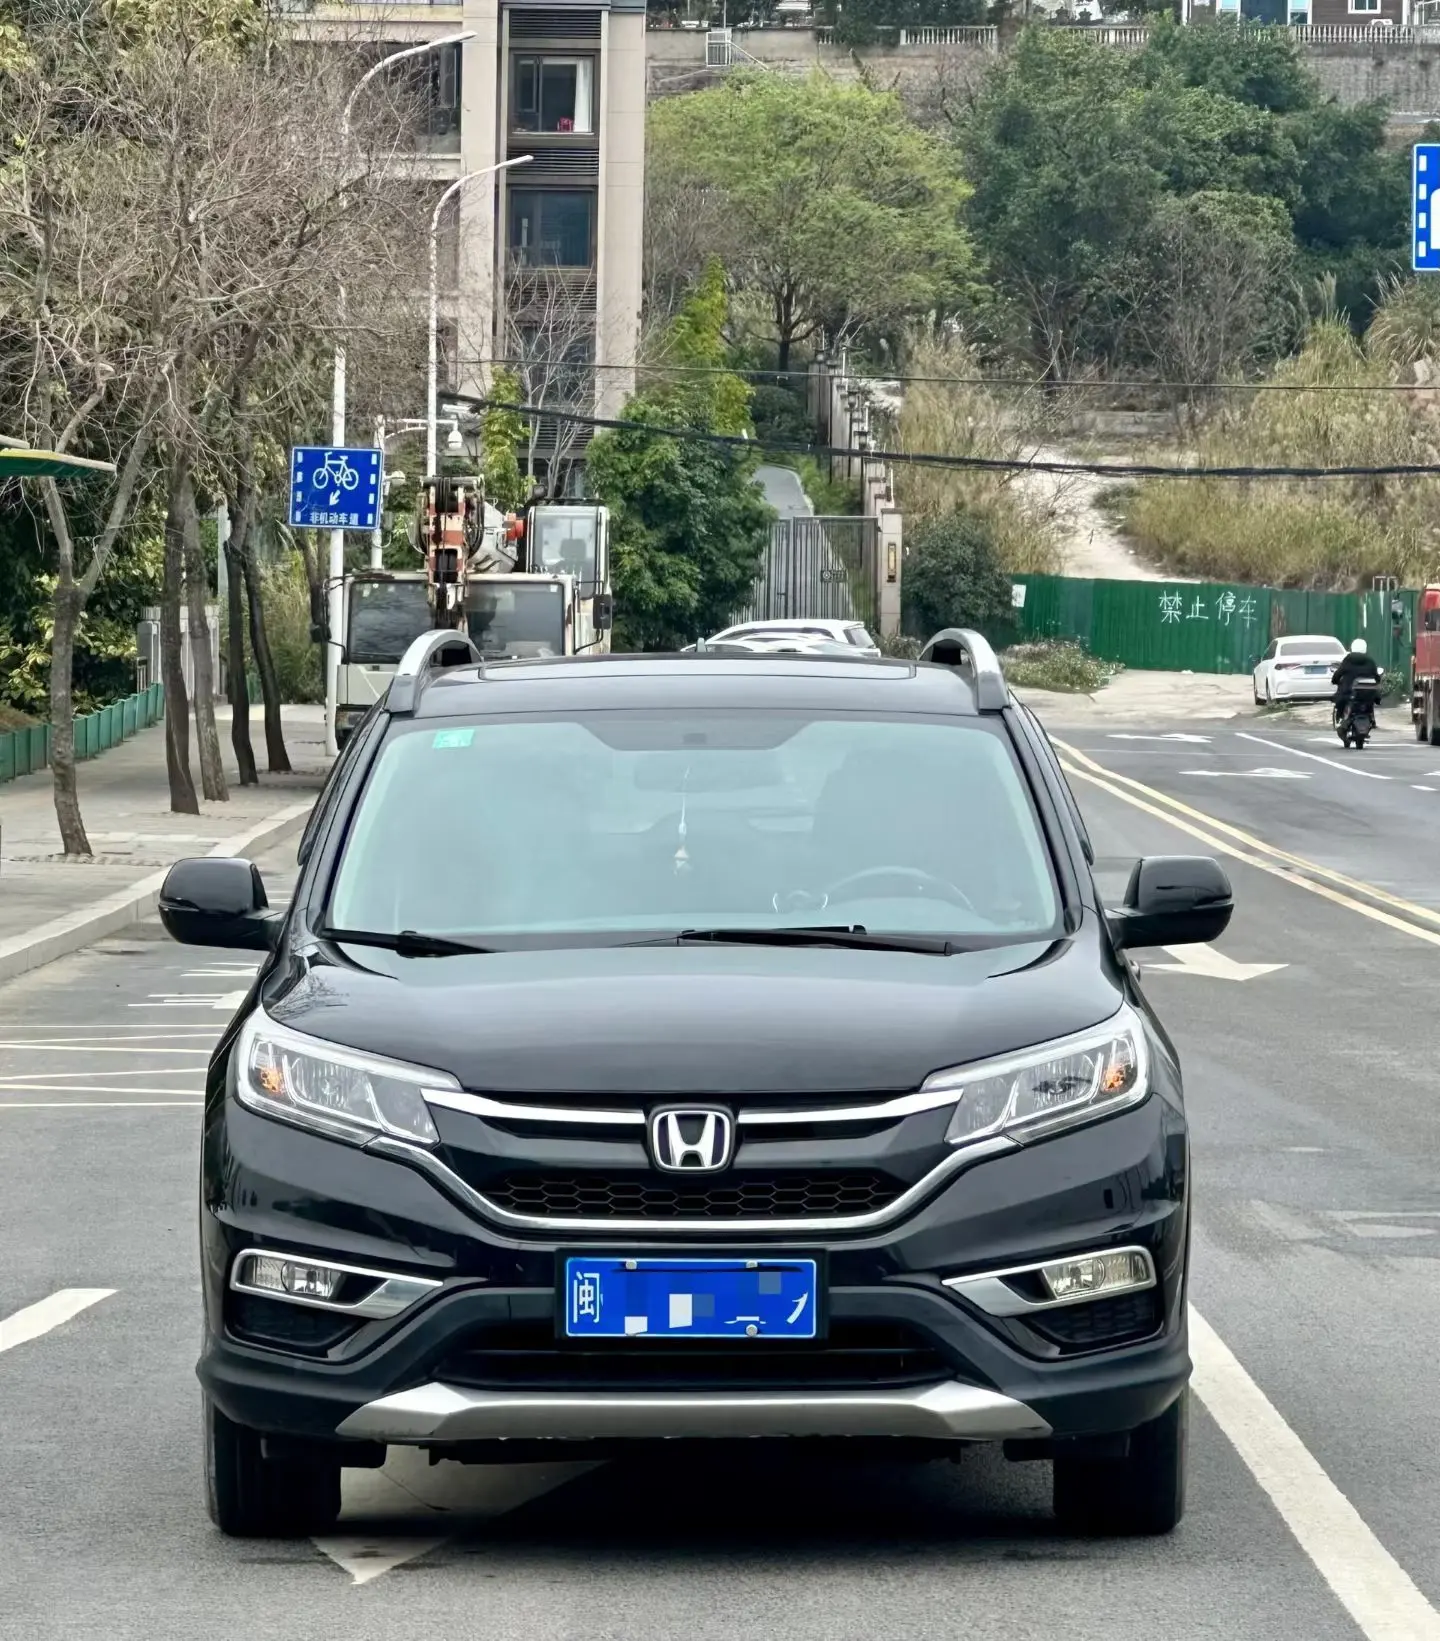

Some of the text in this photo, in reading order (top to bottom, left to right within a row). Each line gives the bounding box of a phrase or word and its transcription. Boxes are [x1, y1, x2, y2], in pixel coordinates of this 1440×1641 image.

[309, 511, 359, 525] 非机动车道
[1158, 590, 1258, 629] 禁止停车
[573, 1271, 600, 1324] 闽
